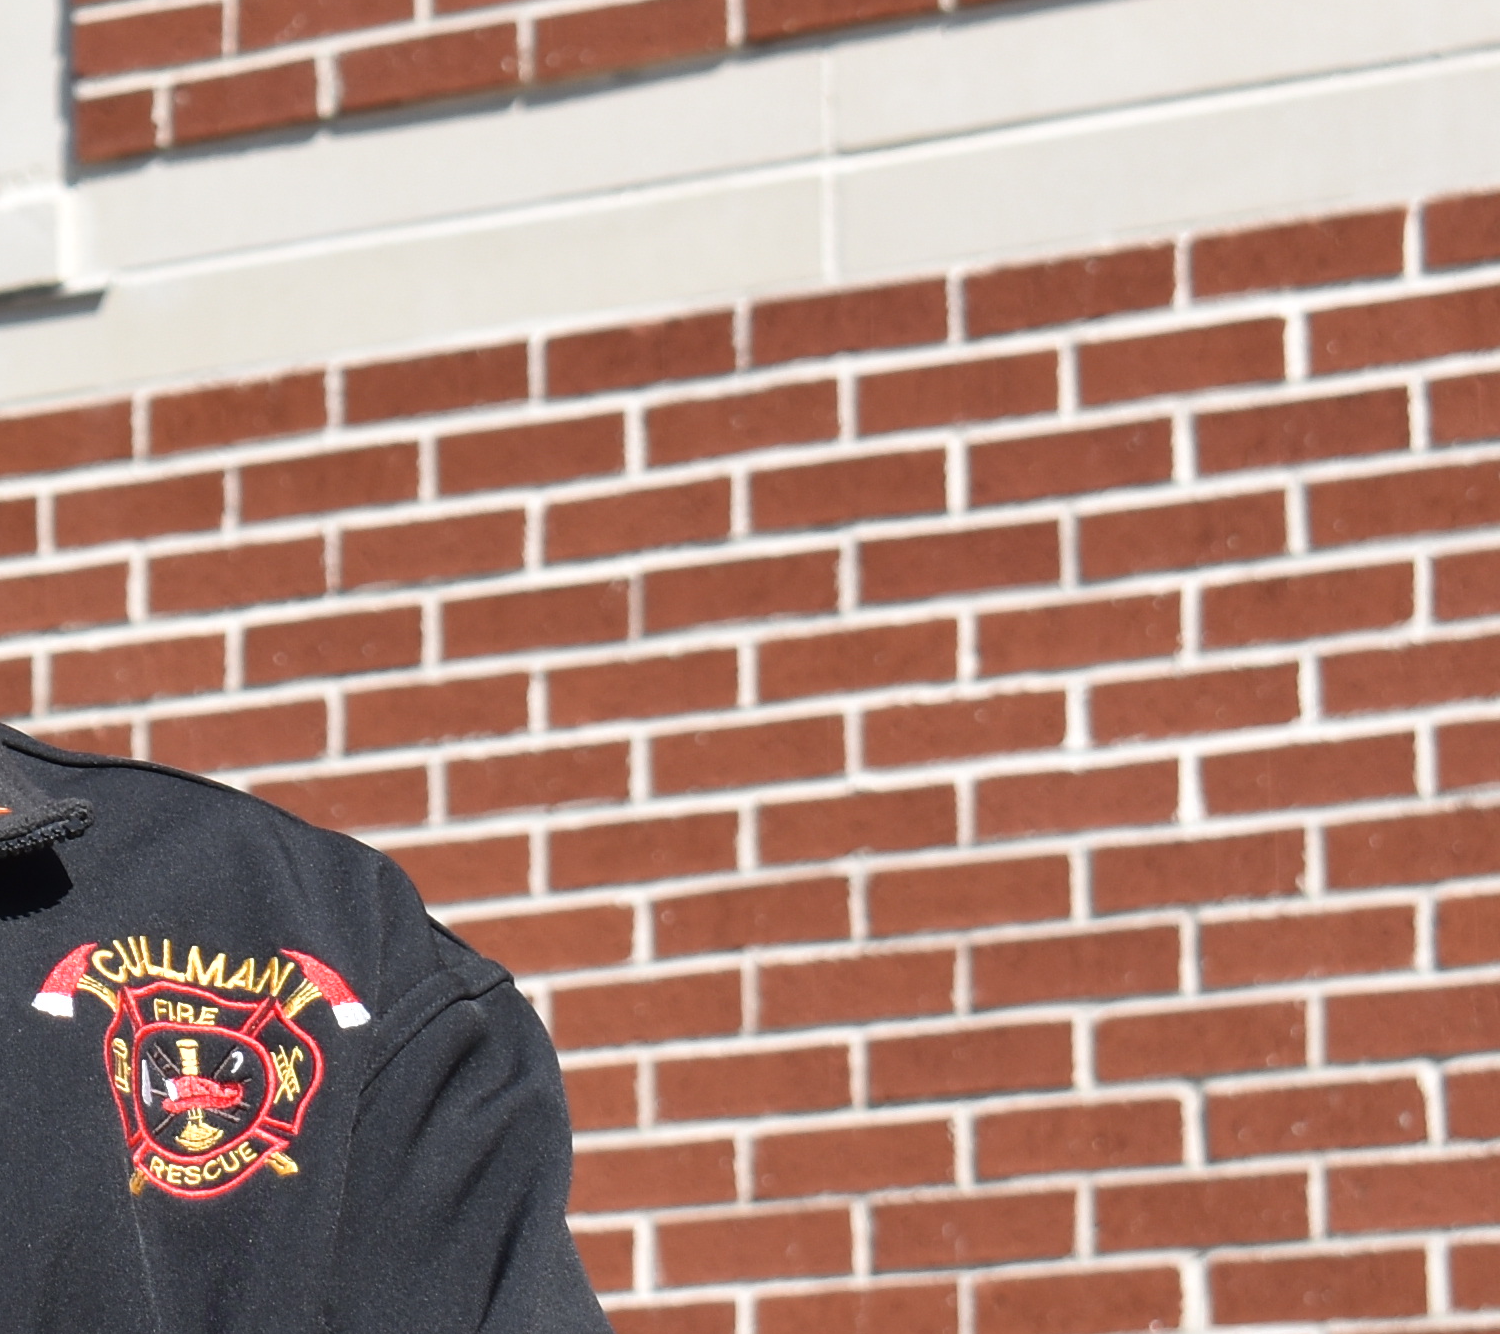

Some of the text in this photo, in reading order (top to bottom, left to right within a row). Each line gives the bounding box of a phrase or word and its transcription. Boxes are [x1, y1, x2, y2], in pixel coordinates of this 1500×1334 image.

[92, 935, 295, 996] CULLMAN
[153, 998, 219, 1026] FIRE
[150, 1141, 257, 1185] RESCUE
